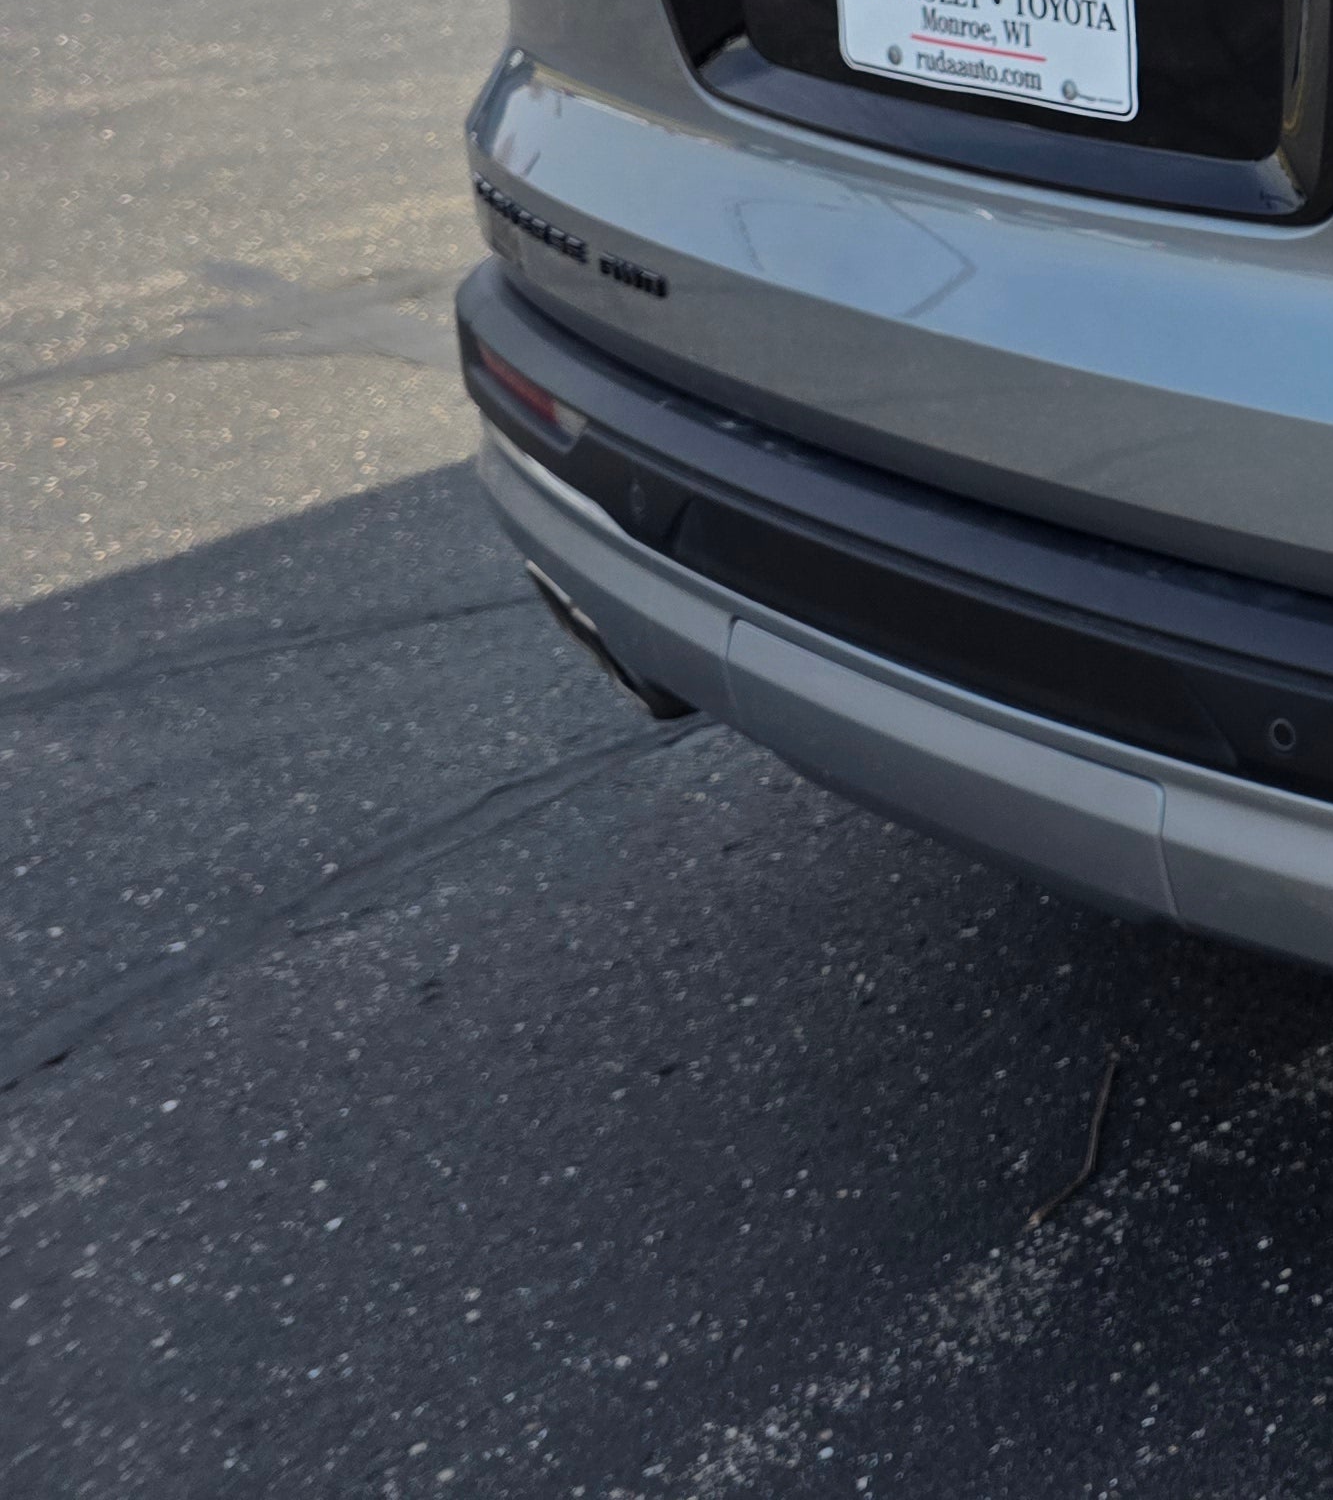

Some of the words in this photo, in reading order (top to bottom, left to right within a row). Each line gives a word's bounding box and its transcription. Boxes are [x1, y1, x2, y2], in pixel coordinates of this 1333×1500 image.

[921, 6, 998, 46] Monroe,
[1003, 21, 1032, 48] WI
[916, 49, 1043, 91] rudaauto.com
